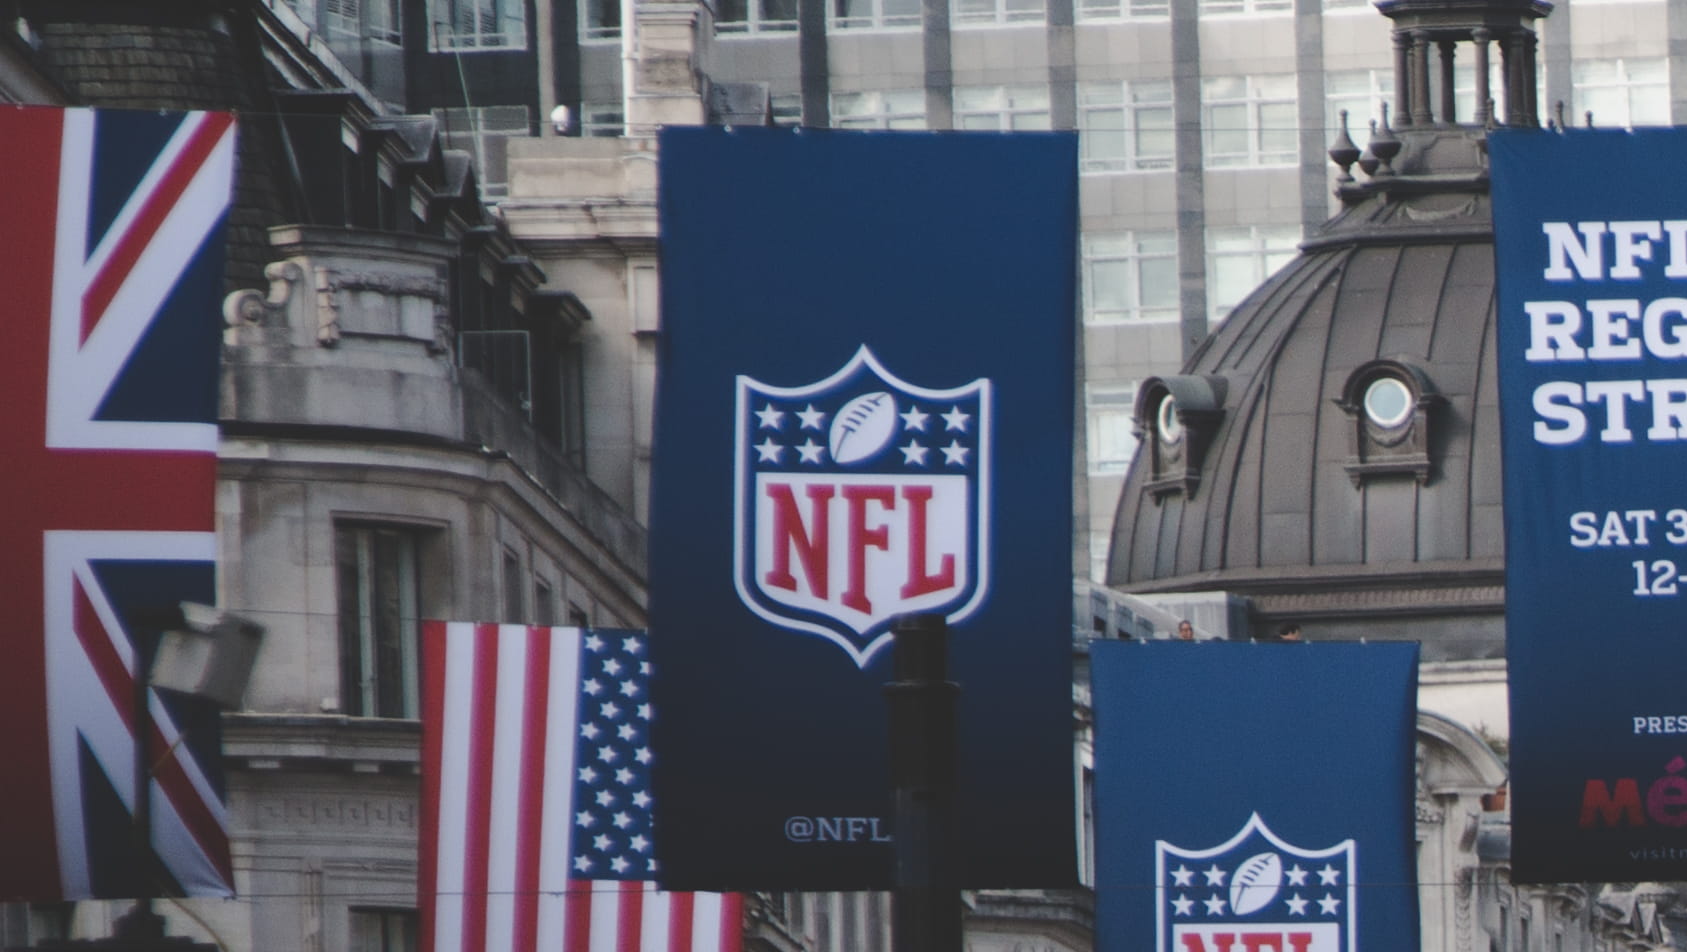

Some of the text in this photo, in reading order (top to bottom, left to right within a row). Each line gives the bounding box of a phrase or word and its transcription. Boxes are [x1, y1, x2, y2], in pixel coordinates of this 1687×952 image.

[1569, 509, 1656, 548] SAT
[765, 482, 956, 616] NFL
[784, 816, 892, 843] @NFL
